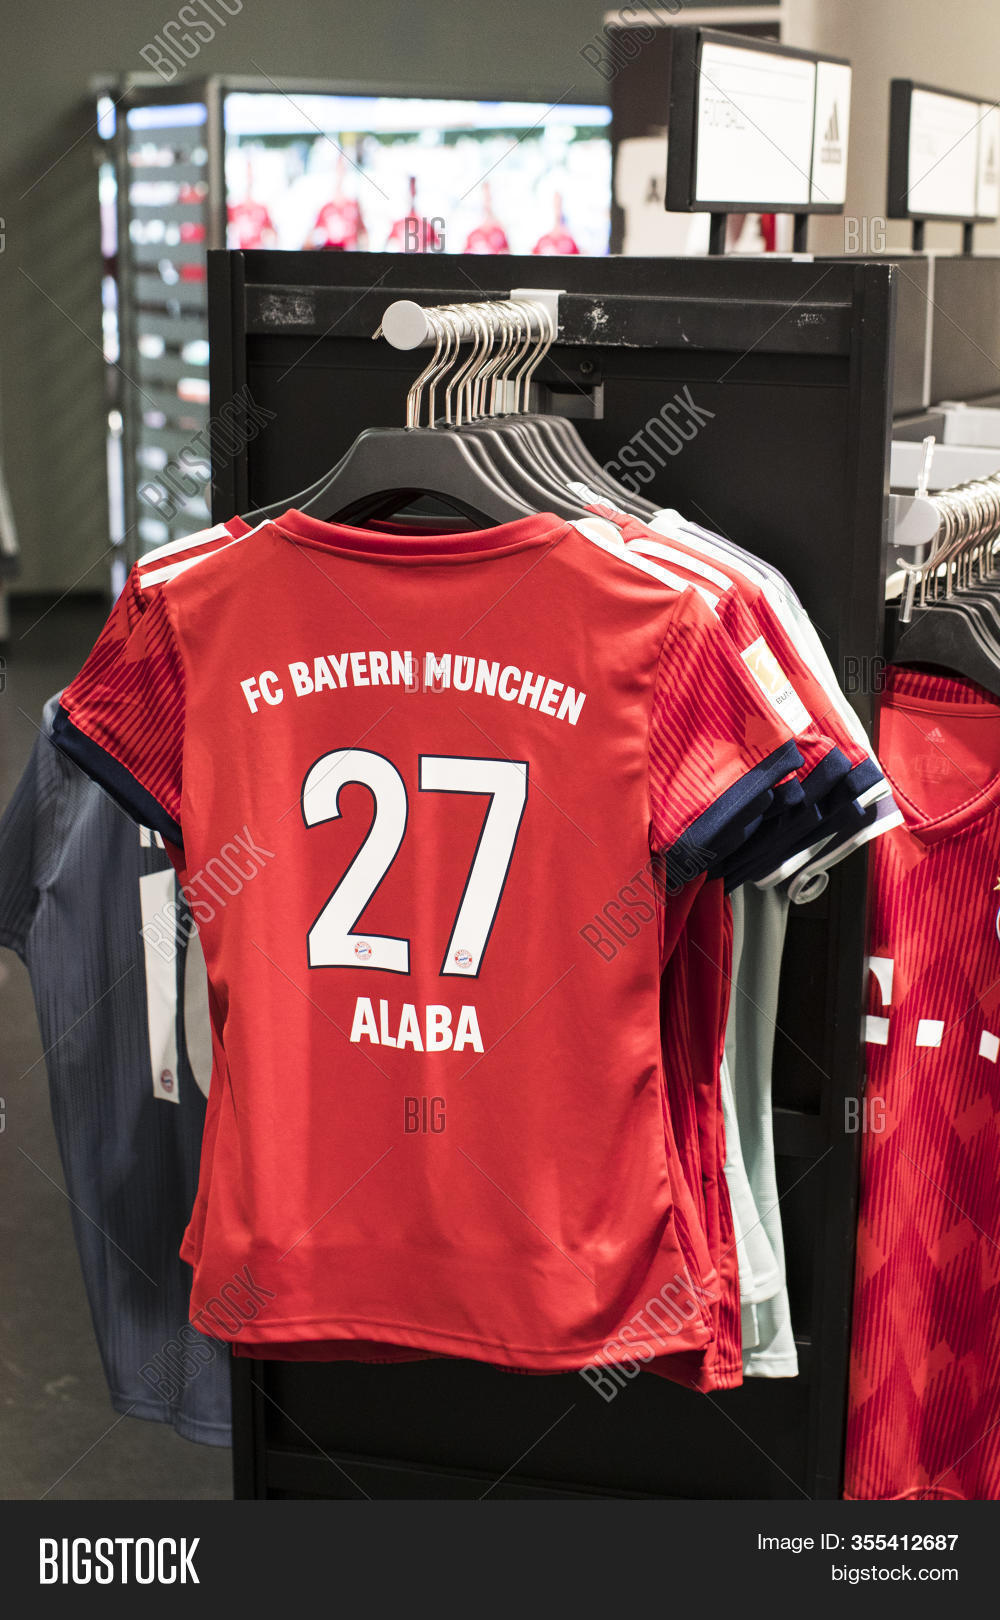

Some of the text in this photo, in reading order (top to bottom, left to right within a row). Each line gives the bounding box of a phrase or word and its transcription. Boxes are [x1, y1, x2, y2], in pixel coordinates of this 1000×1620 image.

[240, 650, 587, 726] FC BAYERN MÜNCHEN
[301, 748, 530, 978] 27
[350, 996, 485, 1053] ALABA
